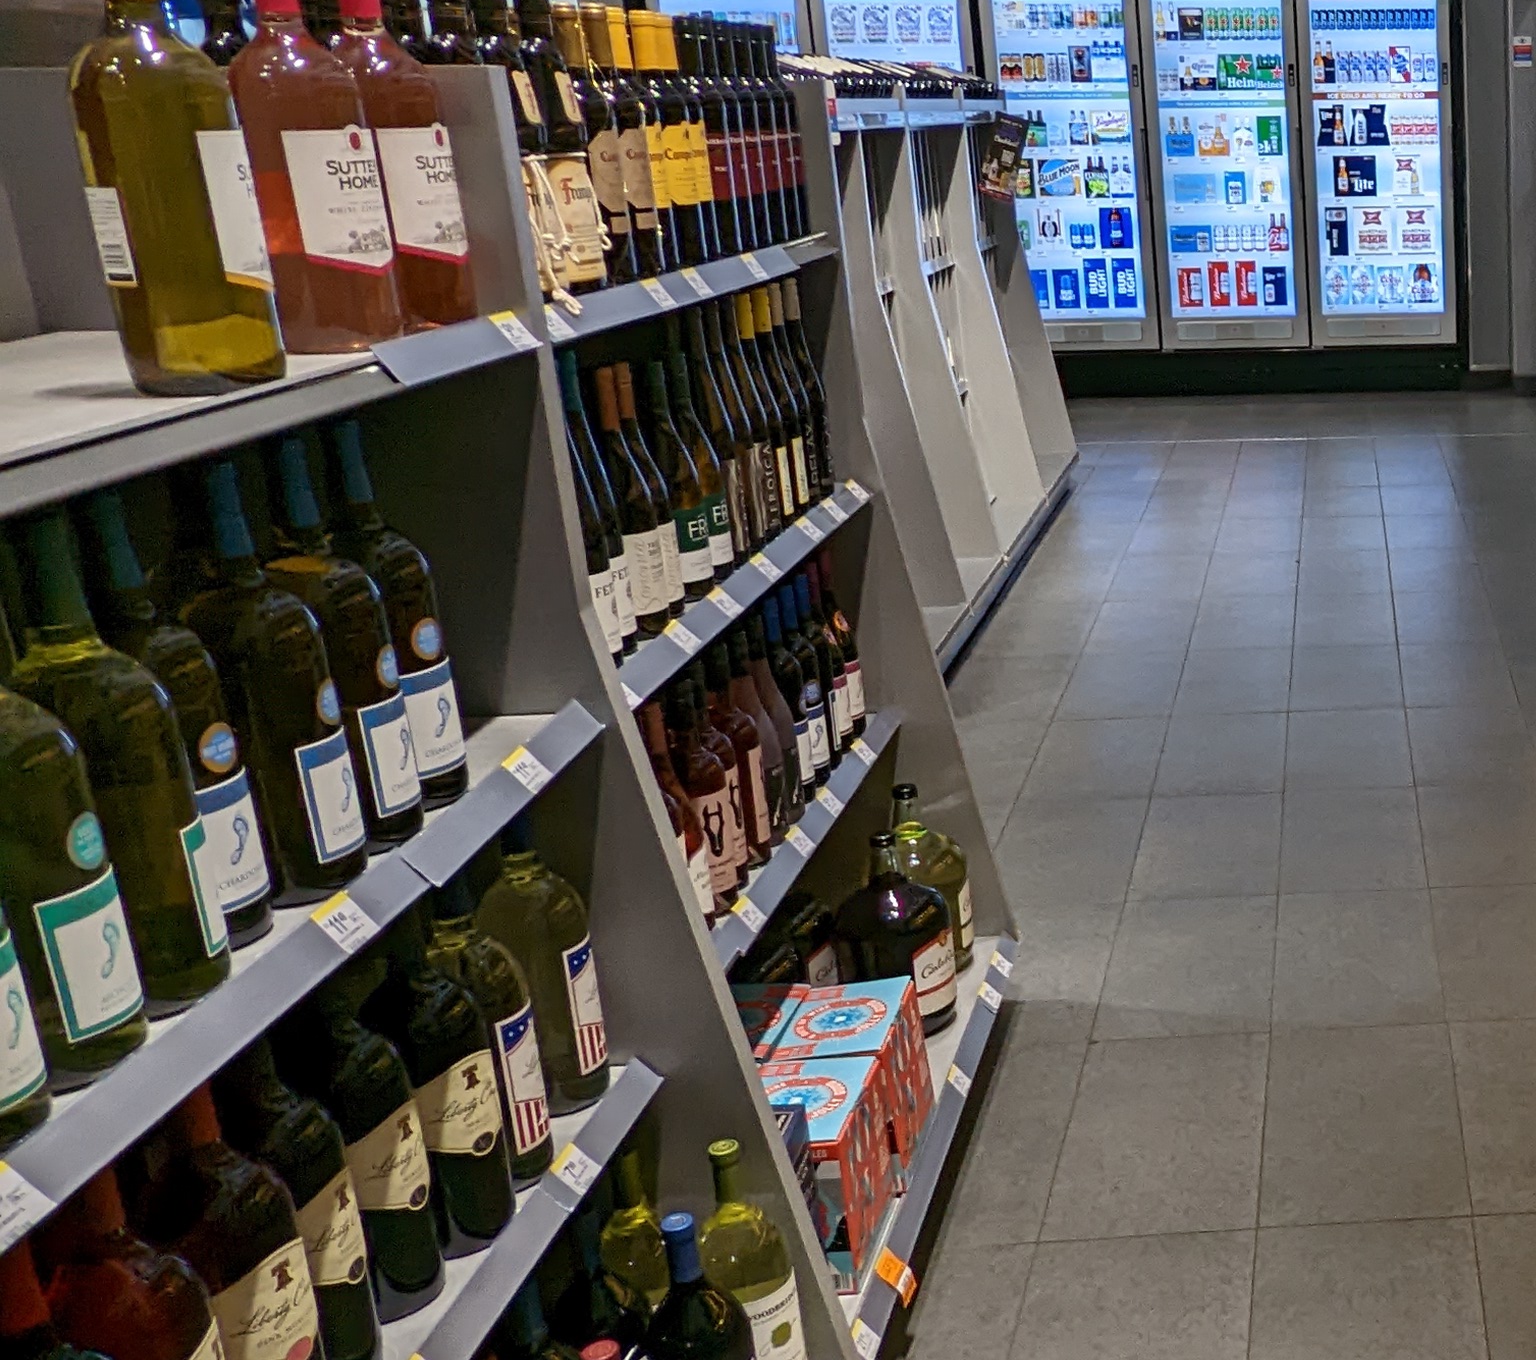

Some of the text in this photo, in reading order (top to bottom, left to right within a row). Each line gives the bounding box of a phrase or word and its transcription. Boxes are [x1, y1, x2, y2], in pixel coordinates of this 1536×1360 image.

[338, 175, 379, 190] HOME
[1038, 162, 1080, 186] BLUE MOON
[1354, 179, 1375, 192] Lite
[1089, 271, 1098, 295] BUD
[1098, 269, 1108, 297] LIGHT
[1117, 271, 1126, 295] BUD
[1126, 269, 1136, 297] LIGHT
